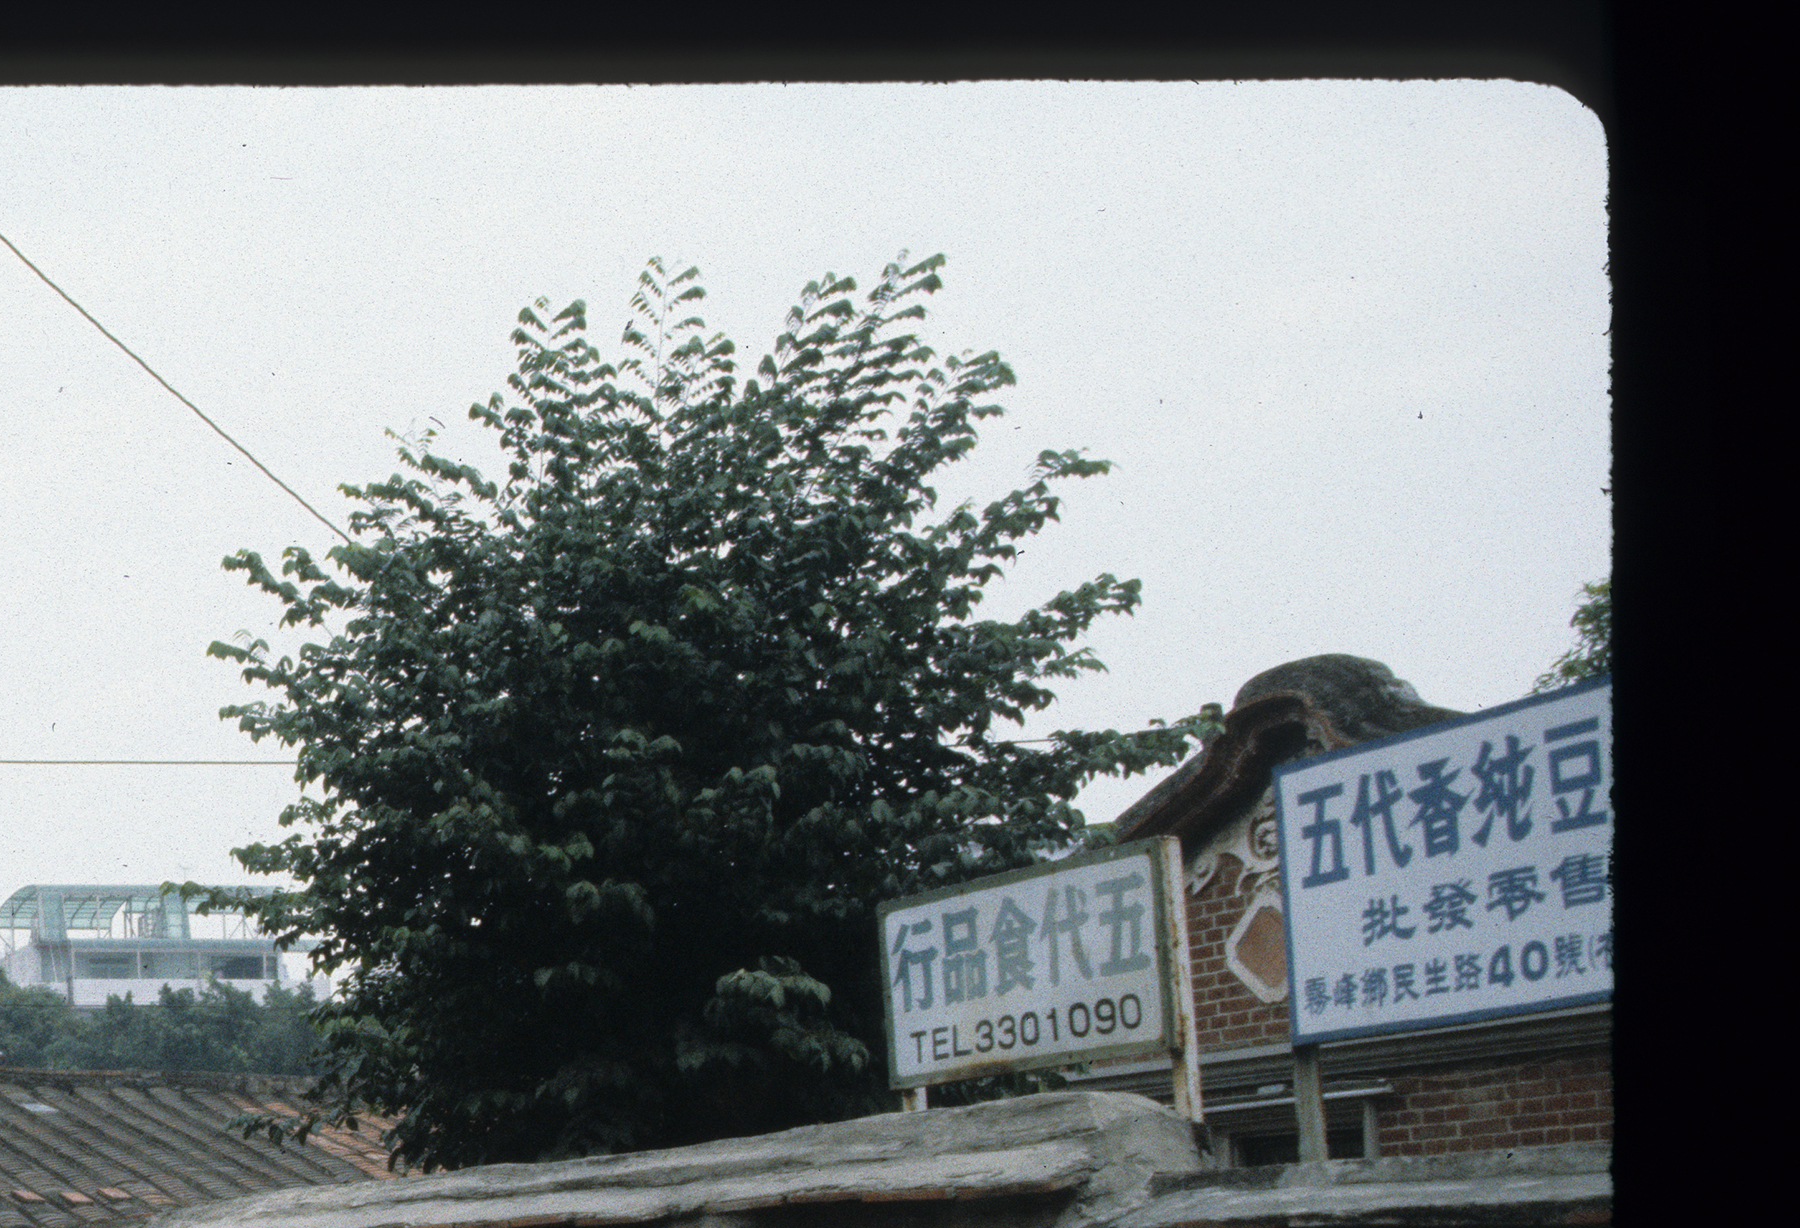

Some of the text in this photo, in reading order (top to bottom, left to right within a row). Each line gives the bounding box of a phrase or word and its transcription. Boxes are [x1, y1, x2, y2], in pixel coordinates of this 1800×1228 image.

[1298, 716, 1607, 889] 五代香純豆
